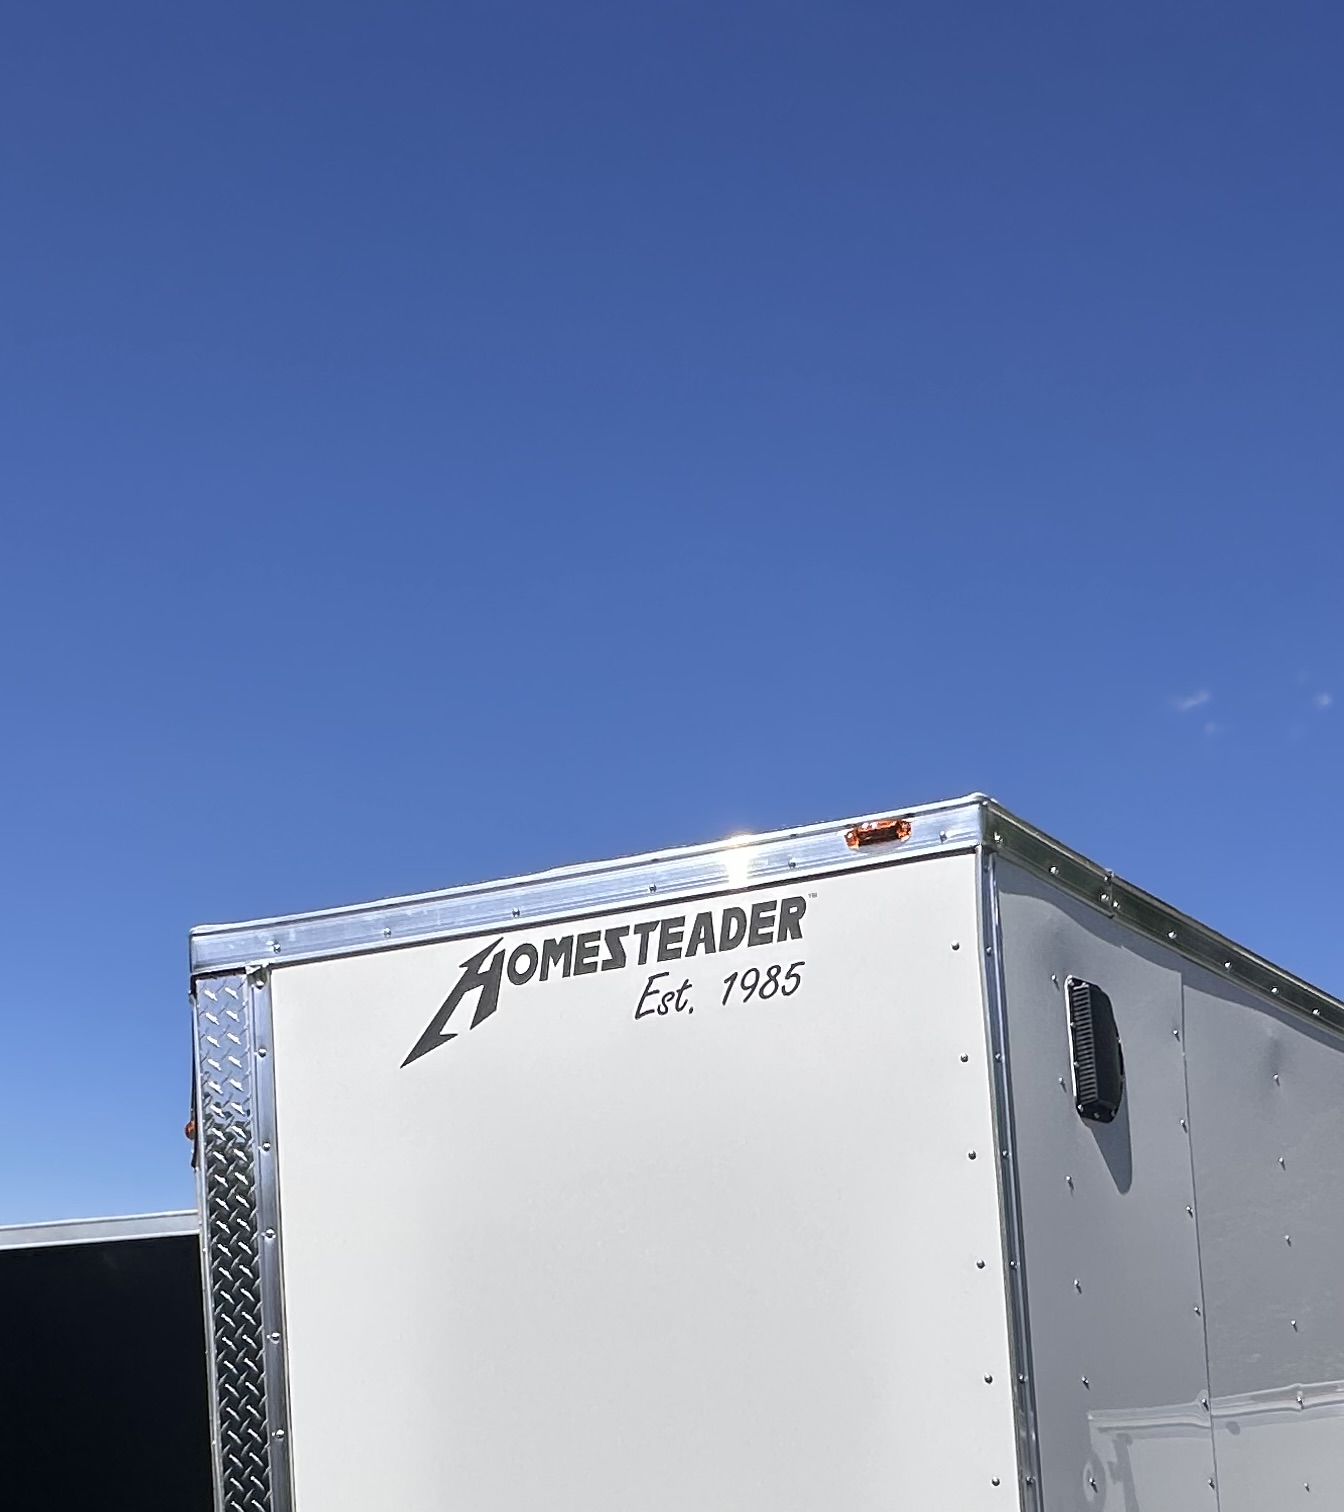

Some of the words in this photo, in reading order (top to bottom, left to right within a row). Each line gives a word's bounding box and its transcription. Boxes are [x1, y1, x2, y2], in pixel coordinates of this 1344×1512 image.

[400, 896, 807, 1068] HOMESTEADER
[634, 970, 694, 1020] Est.
[722, 961, 806, 1006] 1985
